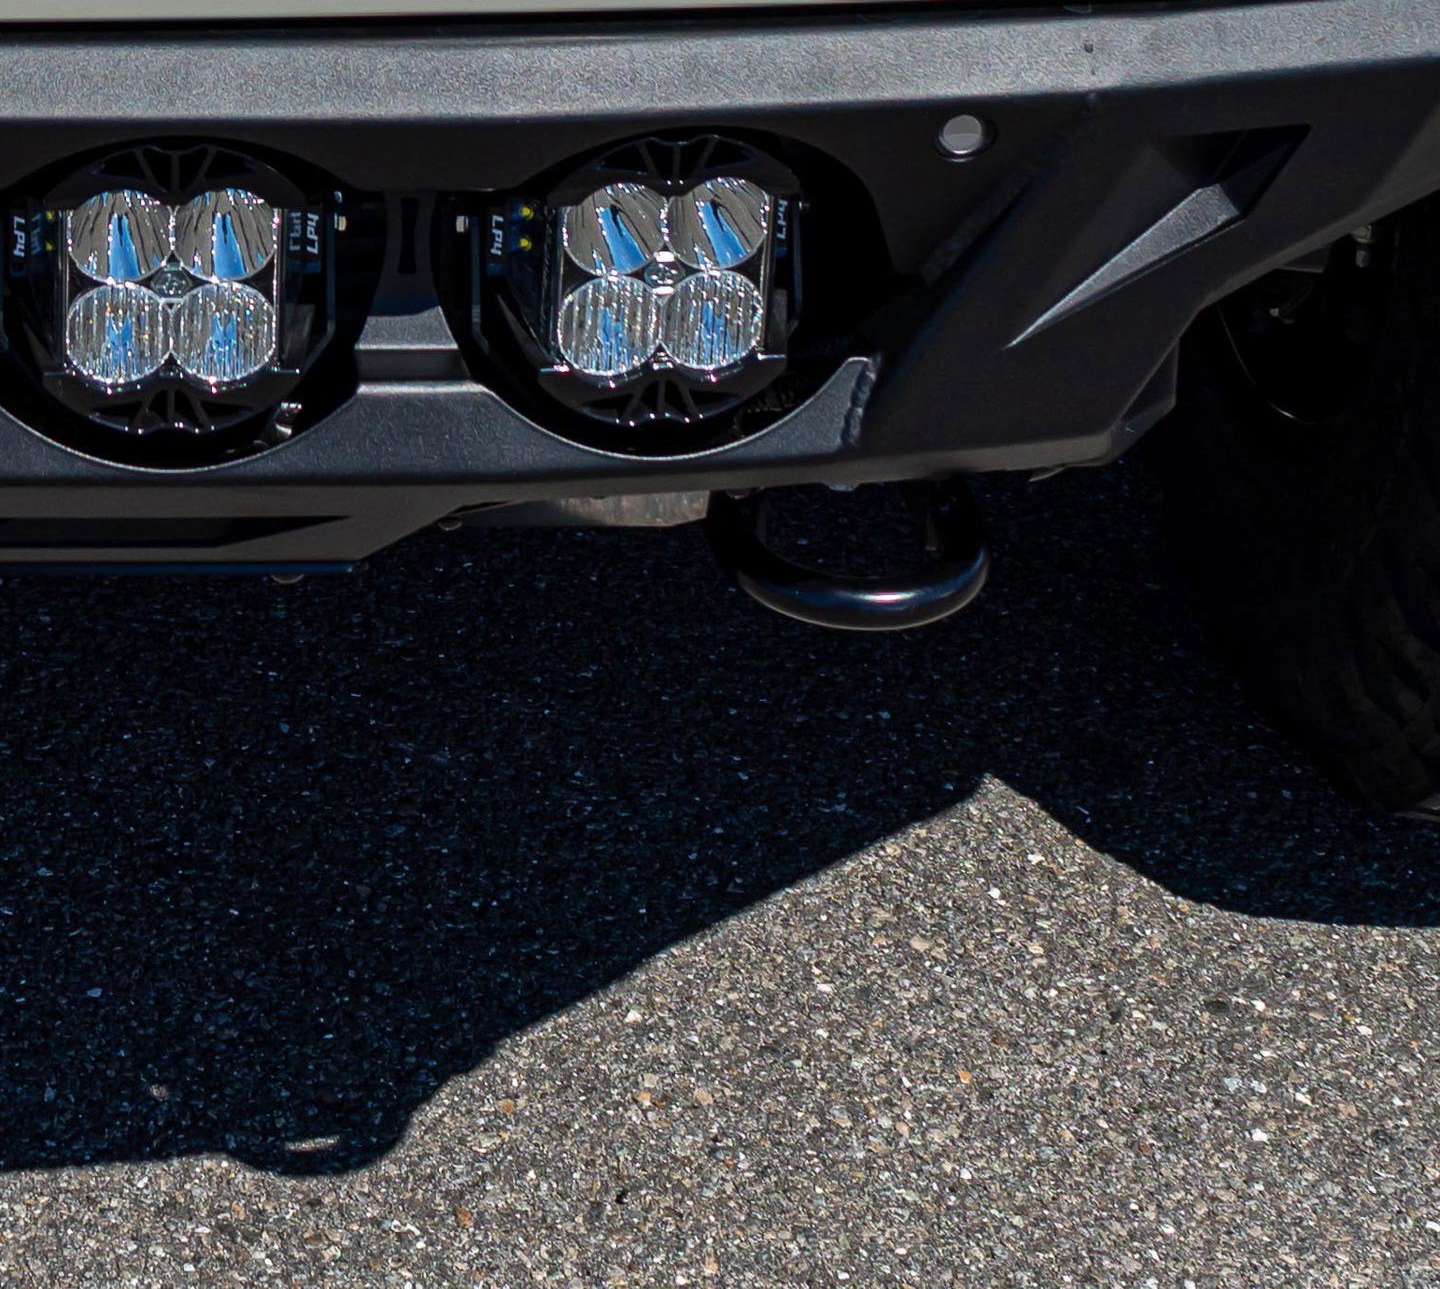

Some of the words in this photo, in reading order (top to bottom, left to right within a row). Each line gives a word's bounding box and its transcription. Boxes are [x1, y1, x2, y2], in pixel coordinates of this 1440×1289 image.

[13, 215, 26, 259] LP4
[306, 212, 320, 256] LP4
[490, 214, 504, 257] LP4
